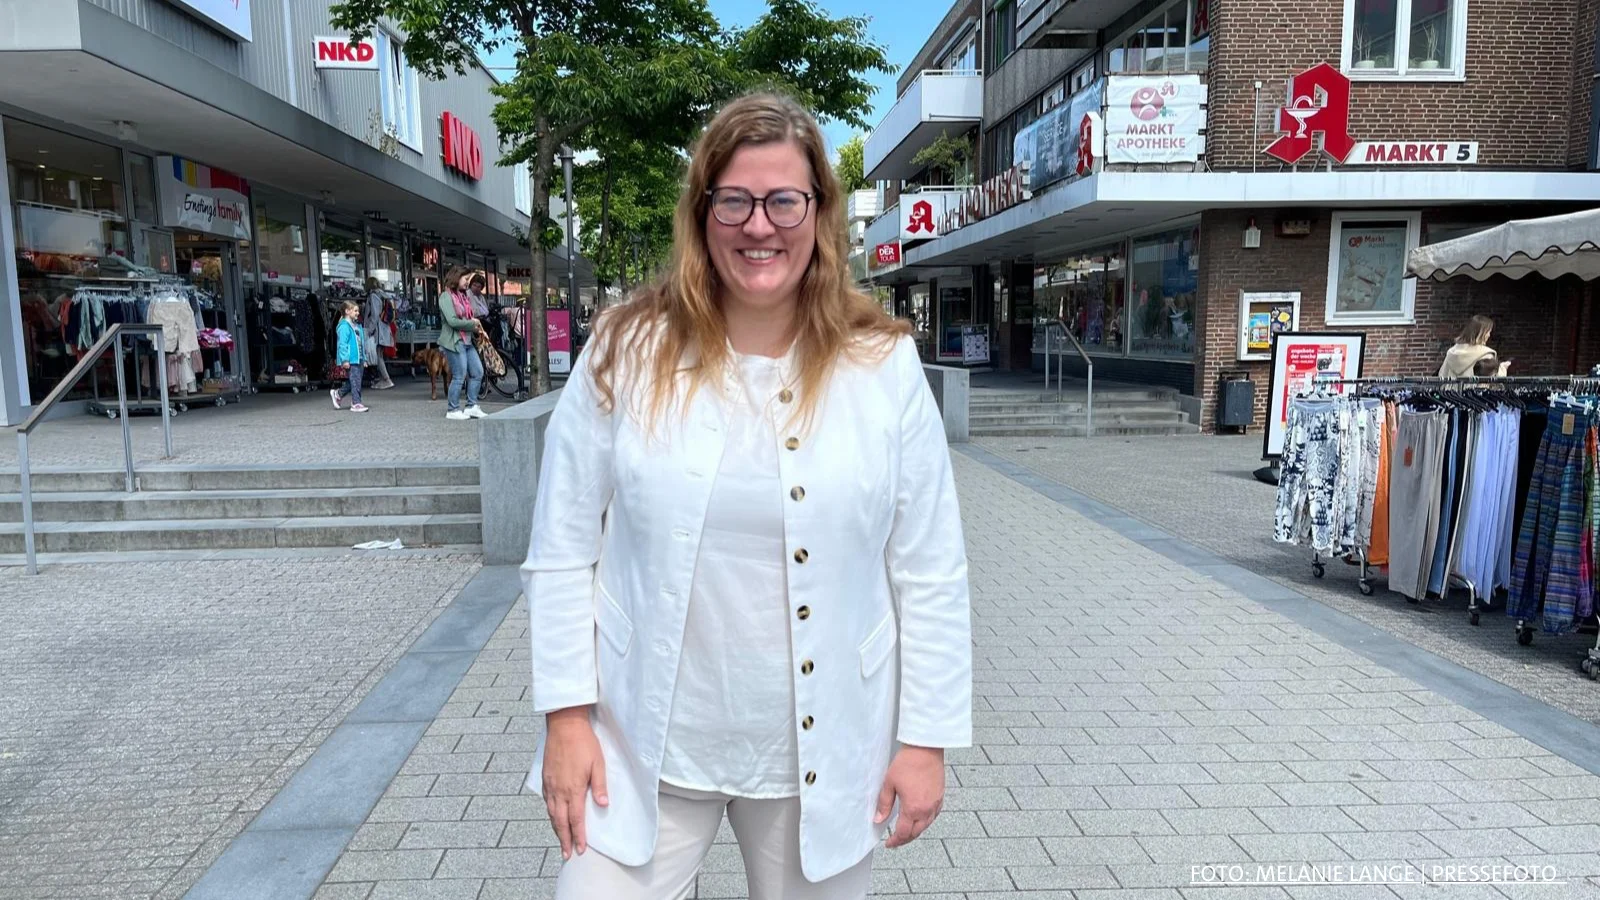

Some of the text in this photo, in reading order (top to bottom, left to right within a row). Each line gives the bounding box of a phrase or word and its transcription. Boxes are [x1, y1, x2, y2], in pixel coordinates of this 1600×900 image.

[318, 41, 374, 62] NKD
[1126, 123, 1175, 135] MARKT
[443, 111, 483, 182] NKD
[1117, 137, 1186, 149] APOTHEKE
[1365, 144, 1470, 162] MARKT 5
[1364, 235, 1385, 243] Markt
[877, 247, 895, 255] DER
